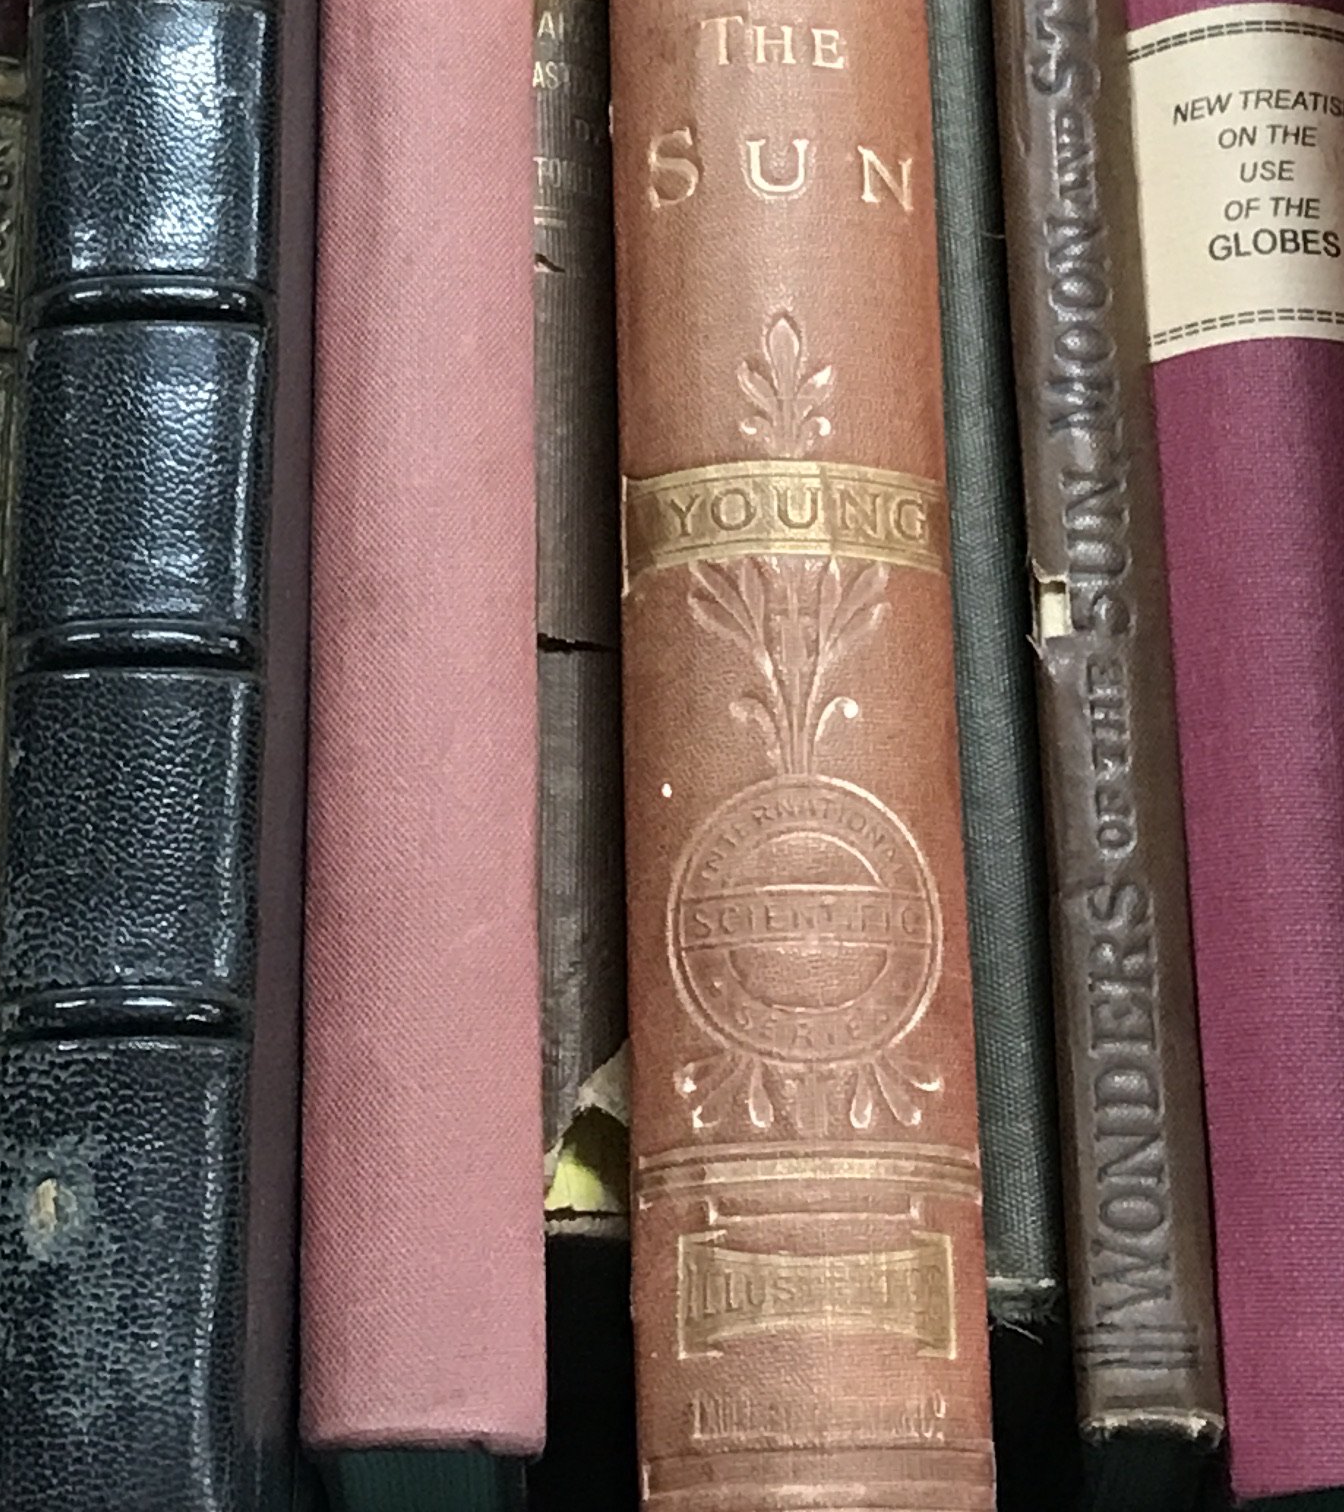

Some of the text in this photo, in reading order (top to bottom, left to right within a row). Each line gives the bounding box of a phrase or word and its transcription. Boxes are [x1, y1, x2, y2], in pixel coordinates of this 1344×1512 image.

[700, 14, 846, 70] THE
[1172, 92, 1233, 126] NEW
[1217, 124, 1318, 150] ON THE
[647, 126, 915, 212] SUN
[1239, 160, 1296, 183] USE
[1223, 196, 1321, 222] OF THE
[1208, 228, 1342, 262] GLOBES
[1042, 216, 1126, 448] MOON
[666, 485, 930, 541] YOUNG
[1083, 654, 1133, 772] THE
[1092, 785, 1139, 857] OF
[1086, 882, 1172, 1322] WONDERS
